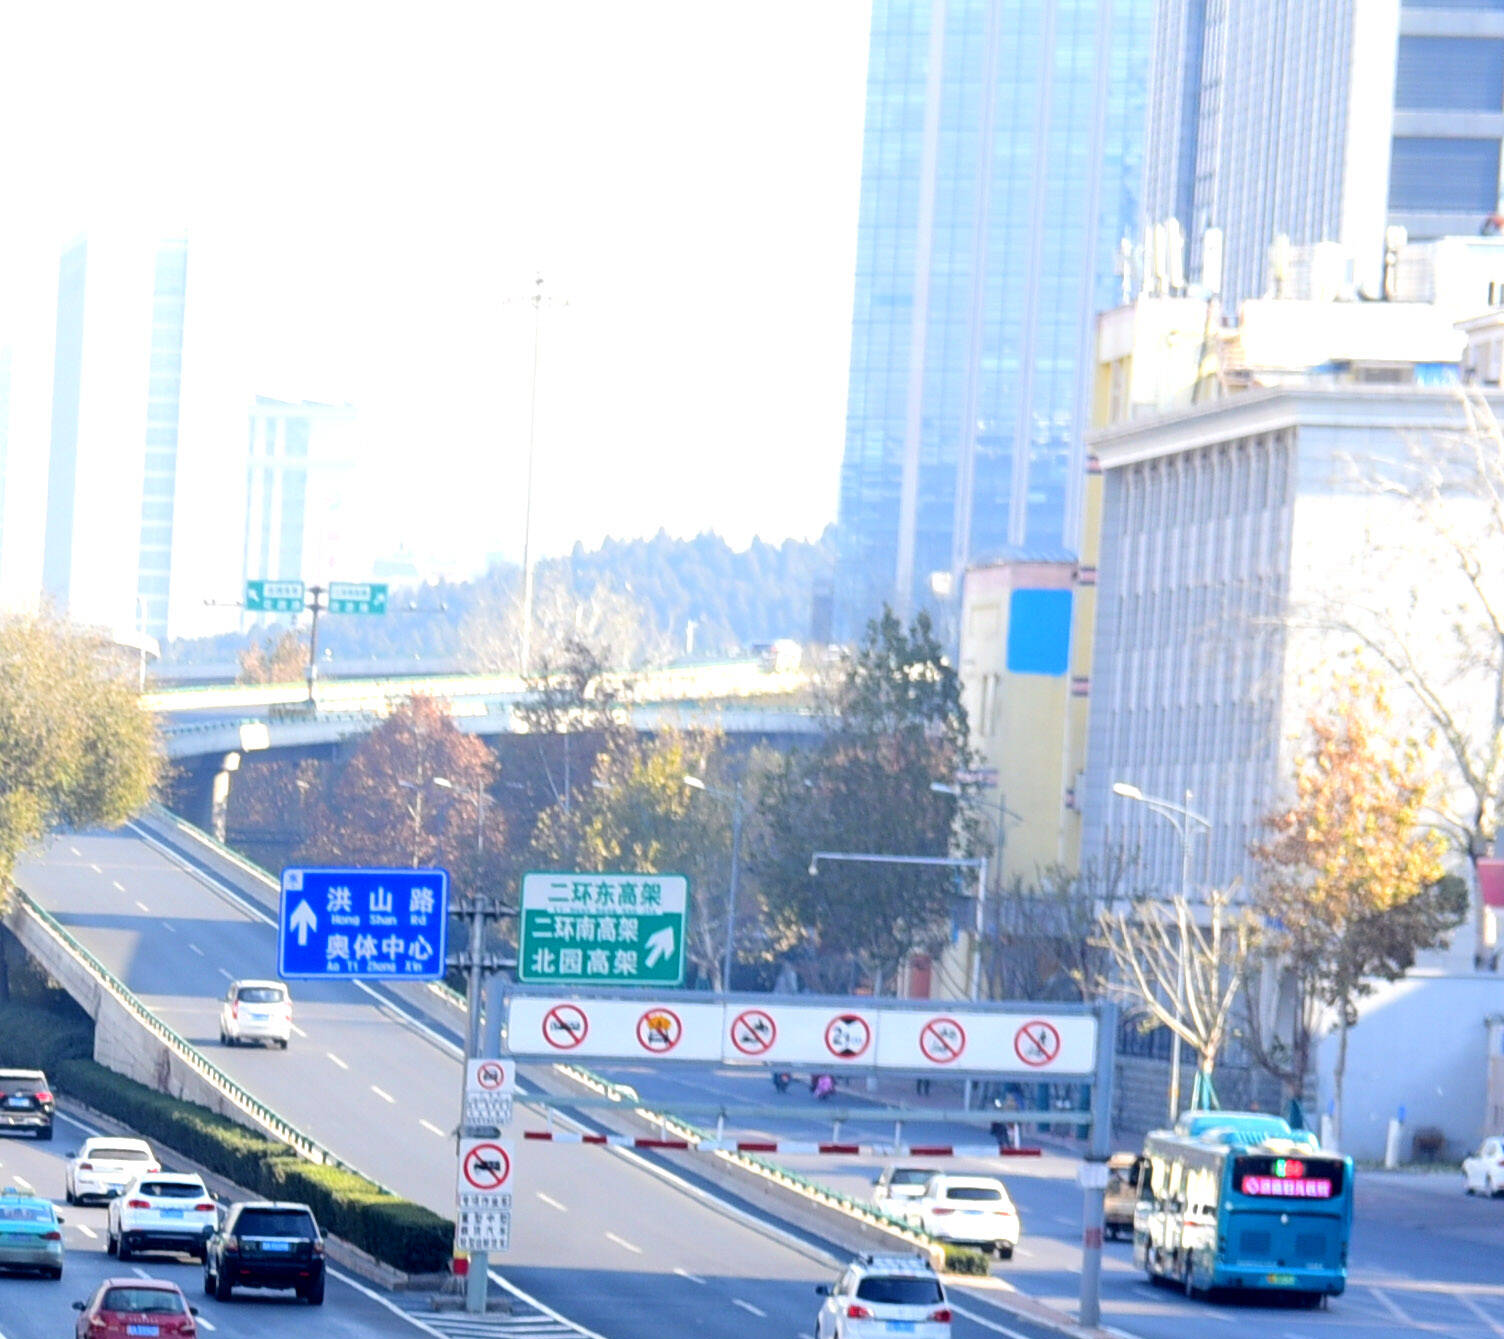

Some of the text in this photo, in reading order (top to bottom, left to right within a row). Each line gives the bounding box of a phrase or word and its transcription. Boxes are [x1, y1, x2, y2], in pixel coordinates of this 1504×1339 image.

[326, 886, 435, 914] 洪山路
[548, 881, 662, 906] 二环东高架
[532, 915, 638, 942] 二环南高架
[326, 933, 433, 960] 奥体中心
[531, 947, 638, 975] 北园高架
